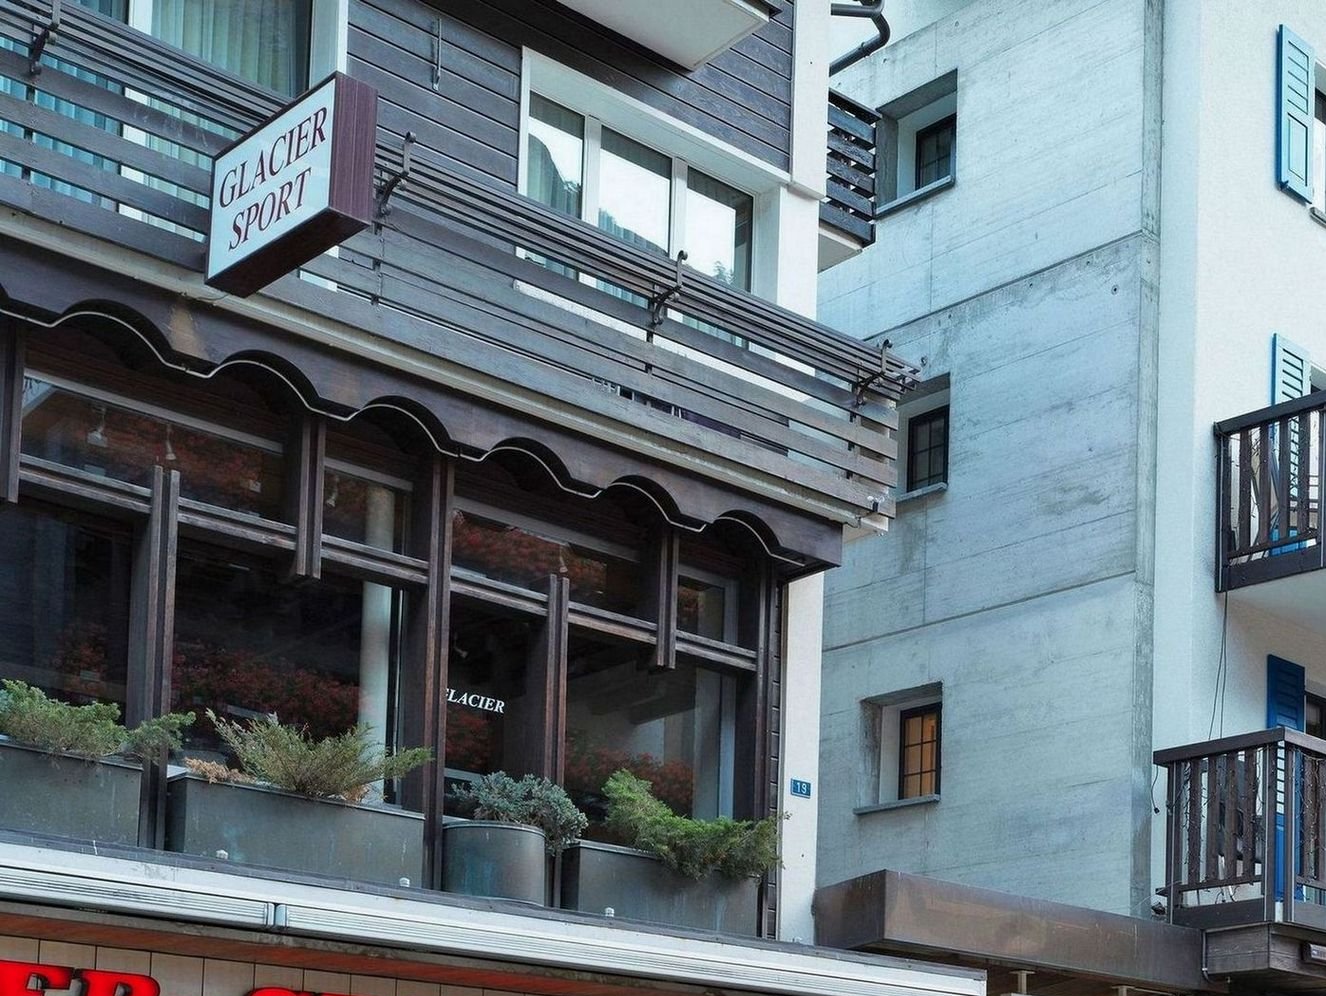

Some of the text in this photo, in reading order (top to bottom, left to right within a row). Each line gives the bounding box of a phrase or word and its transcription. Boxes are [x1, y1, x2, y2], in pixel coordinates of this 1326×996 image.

[220, 107, 328, 208] GLACIER
[229, 167, 312, 250] SPORT
[445, 688, 505, 713] LACIER
